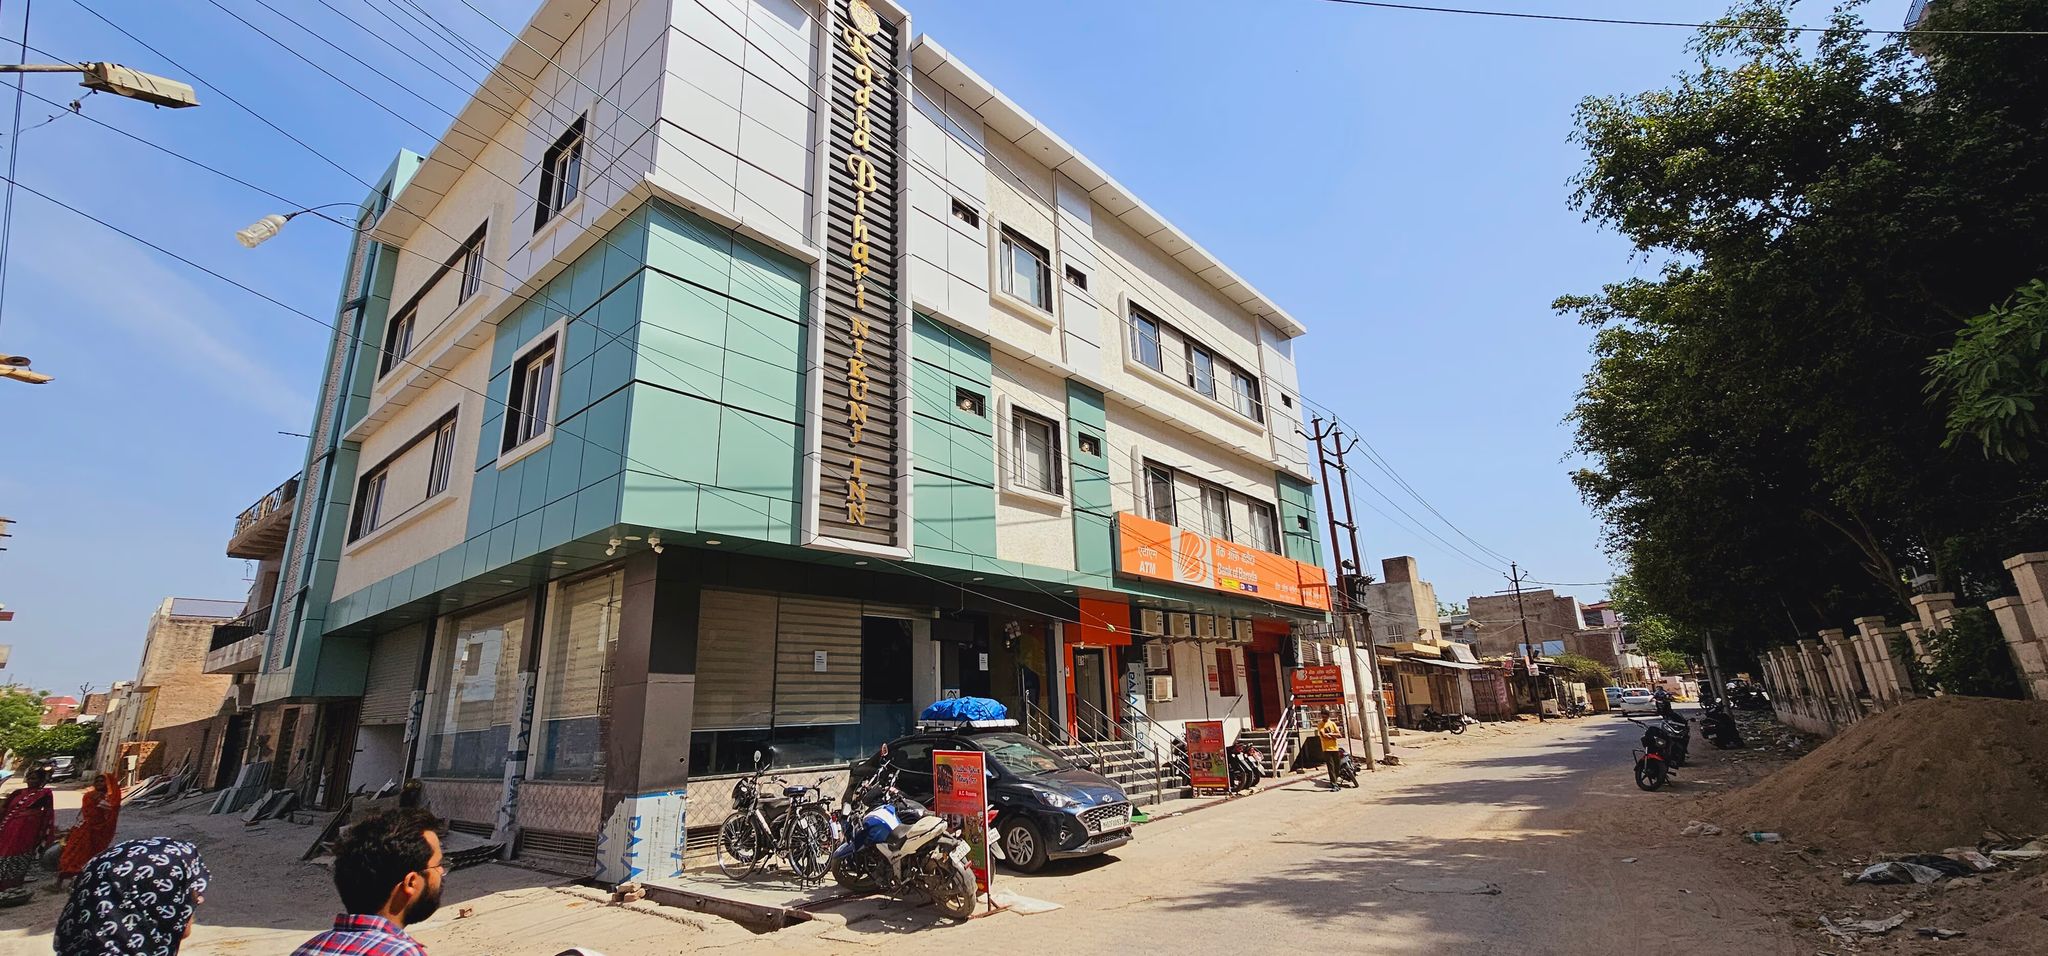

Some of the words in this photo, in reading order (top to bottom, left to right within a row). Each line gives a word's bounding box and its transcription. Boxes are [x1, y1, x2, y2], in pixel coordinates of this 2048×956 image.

[842, 26, 885, 151] Radha
[846, 153, 877, 310] Bihari
[847, 315, 870, 443] NIKUNJ
[846, 457, 868, 526] INN
[1139, 560, 1156, 575] ATM
